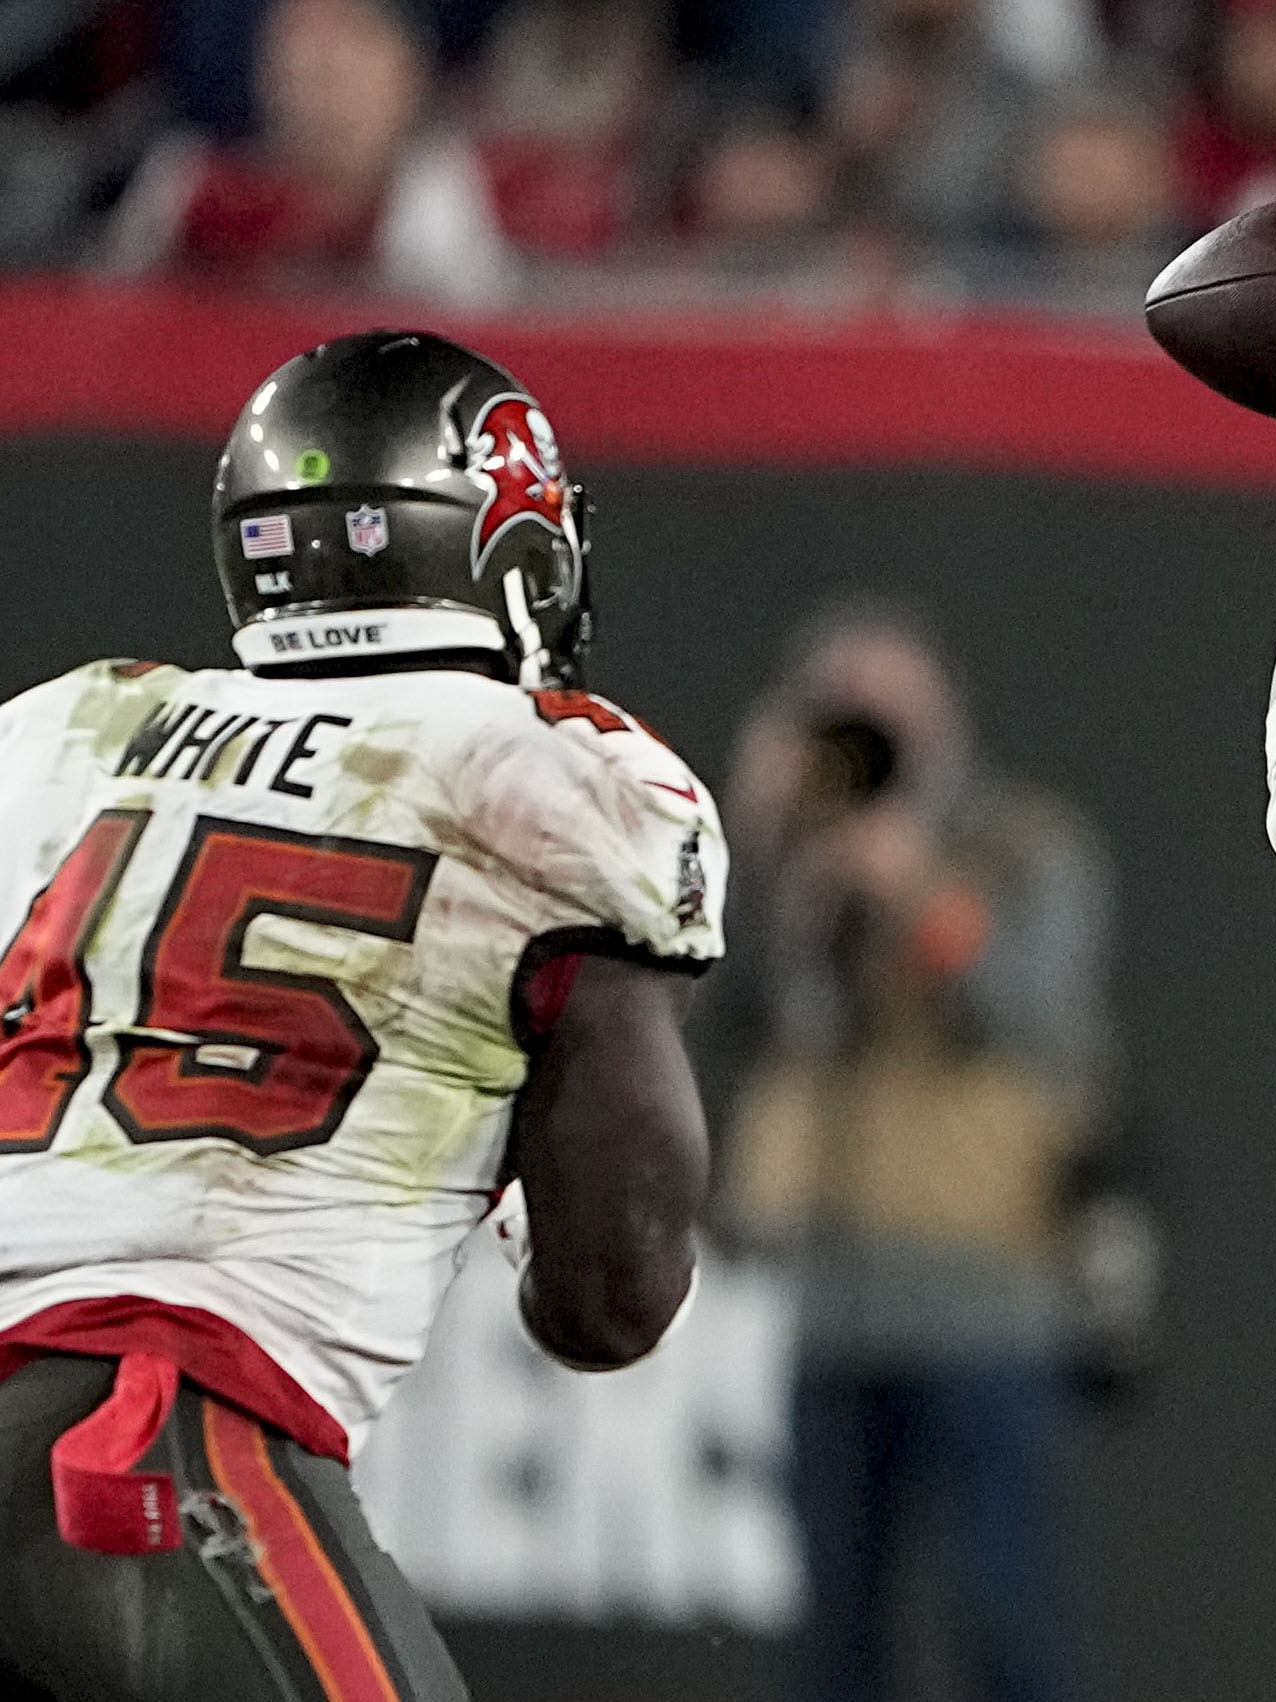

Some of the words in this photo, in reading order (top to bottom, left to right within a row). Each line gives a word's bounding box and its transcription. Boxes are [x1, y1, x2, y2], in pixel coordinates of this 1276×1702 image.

[269, 631, 301, 652] BE
[307, 623, 387, 649] LOVE
[112, 701, 353, 799] WHITE
[0, 809, 440, 1158] 45
